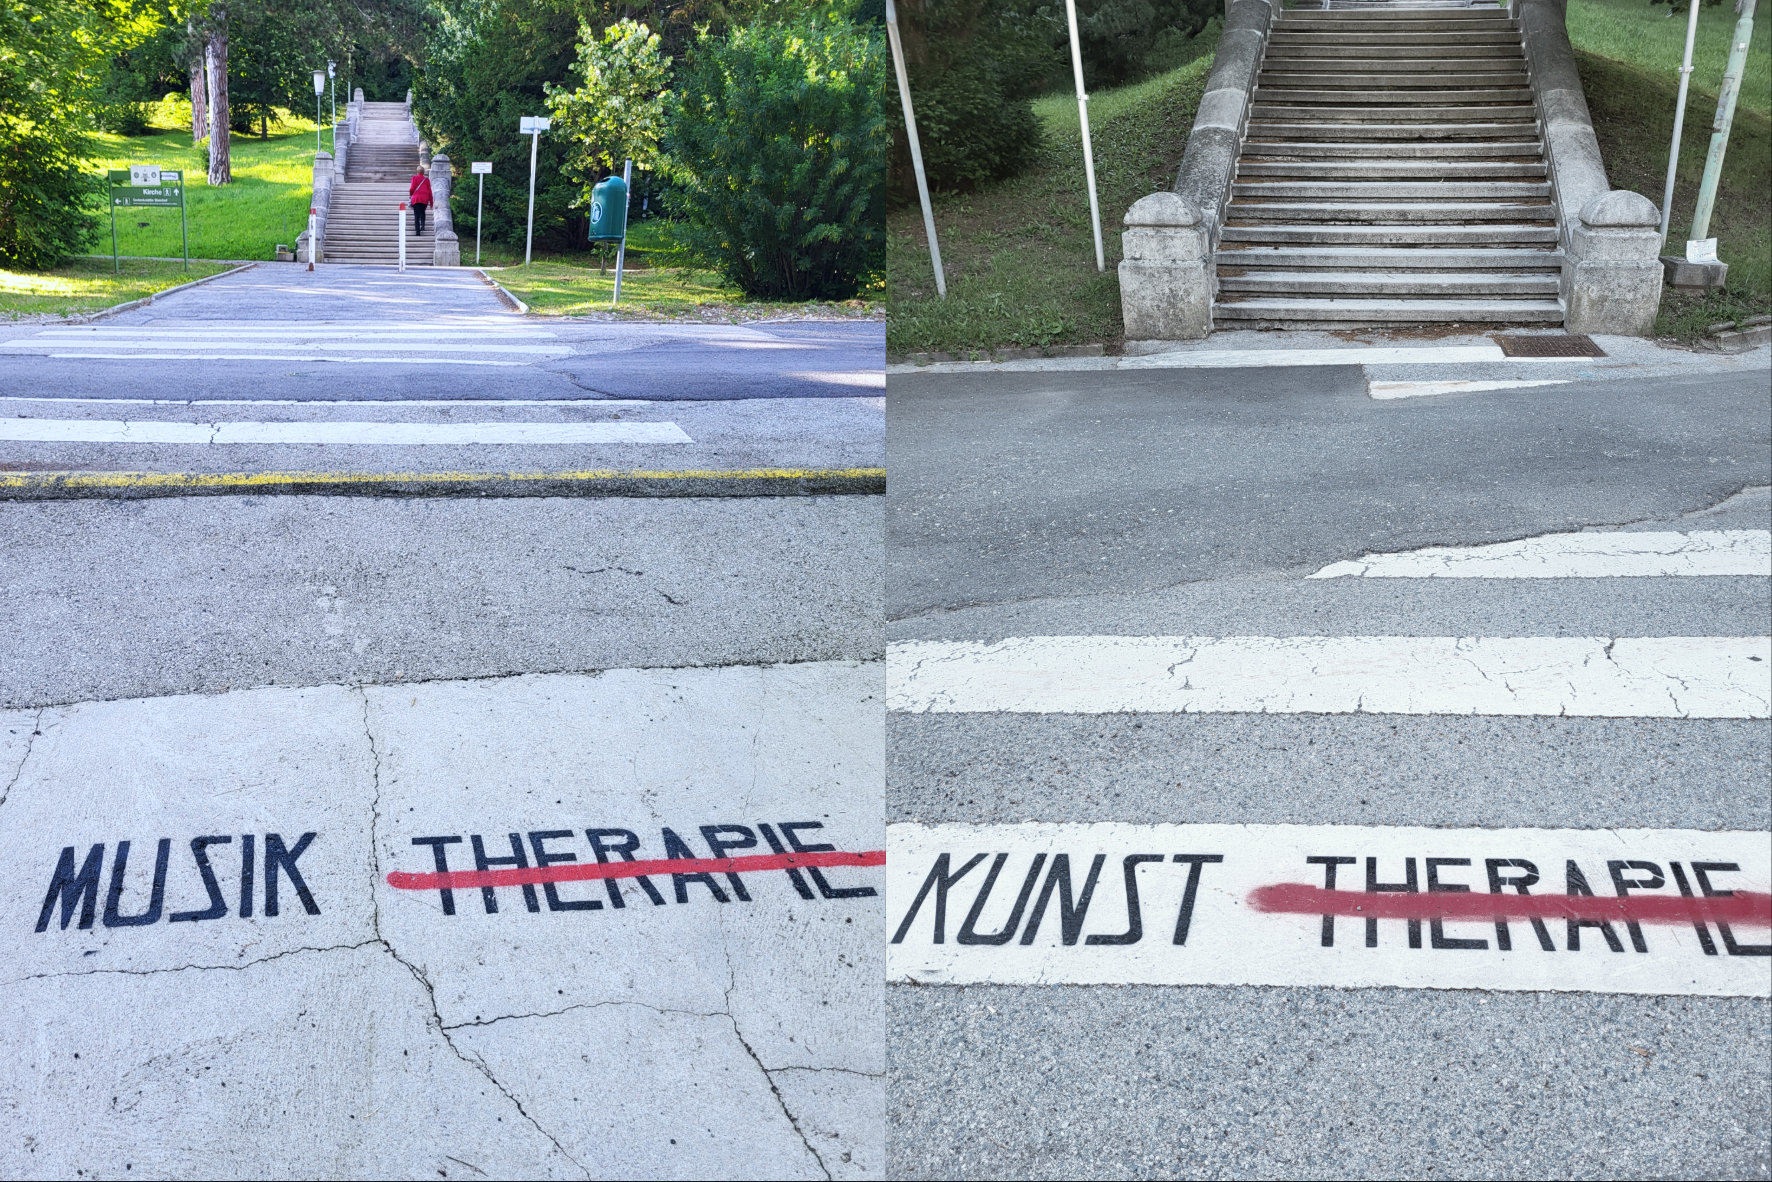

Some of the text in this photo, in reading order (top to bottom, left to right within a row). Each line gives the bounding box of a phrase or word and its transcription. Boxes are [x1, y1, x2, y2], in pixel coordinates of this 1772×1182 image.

[35, 821, 878, 933] MUSIK THERAPIE
[890, 852, 1771, 956] KUNST THERAPIE
